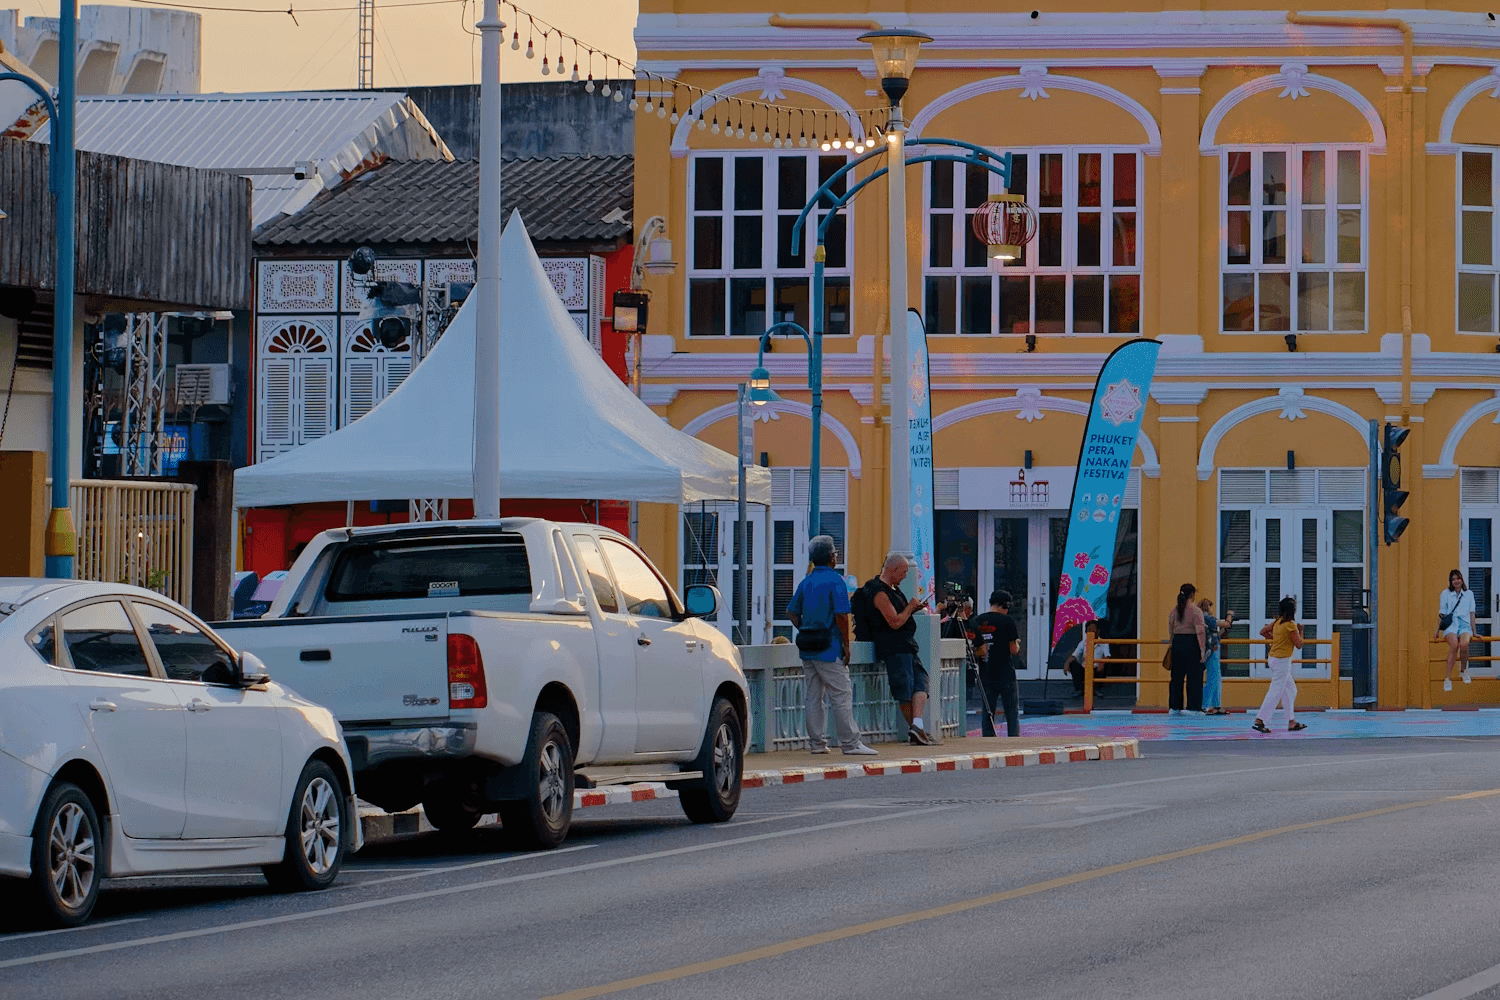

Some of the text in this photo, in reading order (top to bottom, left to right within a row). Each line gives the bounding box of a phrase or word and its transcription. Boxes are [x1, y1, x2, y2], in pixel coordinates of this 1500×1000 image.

[1090, 434, 1134, 446] PHUKET
[1088, 445, 1115, 456] PERA
[1086, 457, 1128, 469] NAKAN
[1084, 469, 1125, 481] FESTIVA
